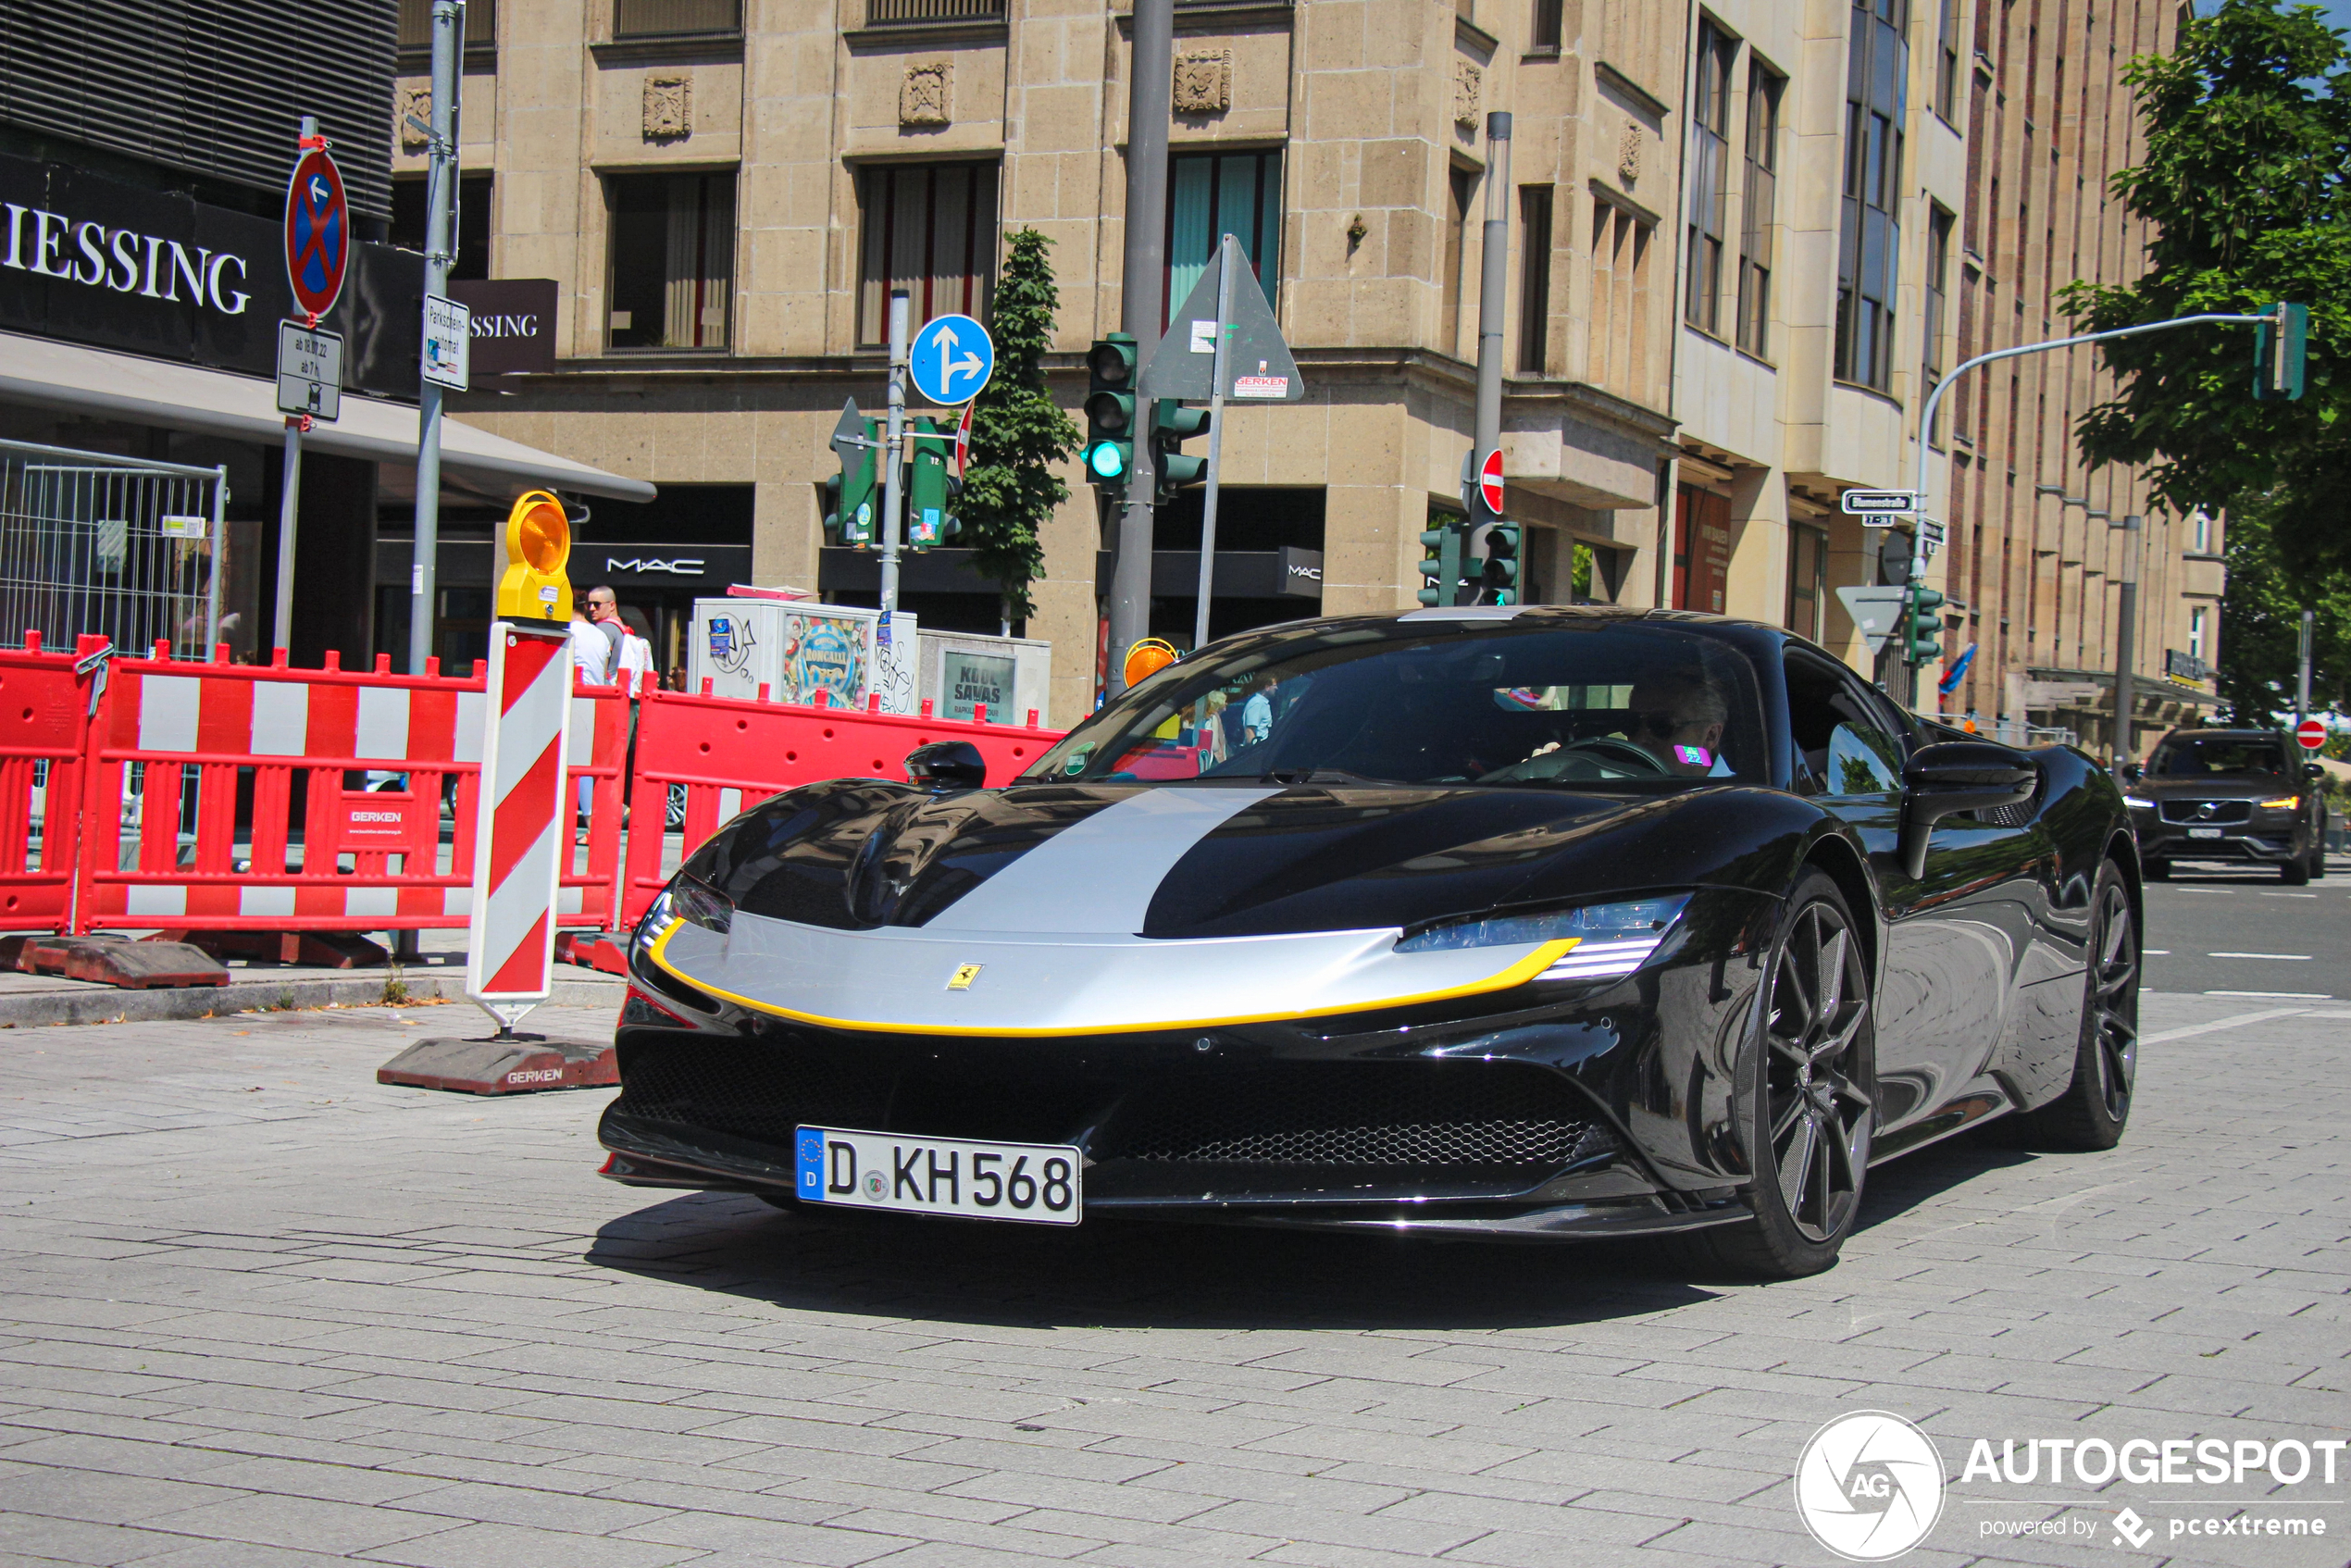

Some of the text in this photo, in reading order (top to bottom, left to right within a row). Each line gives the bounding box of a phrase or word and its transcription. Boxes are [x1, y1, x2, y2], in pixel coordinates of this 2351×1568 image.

[0, 202, 252, 315] IESSING
[470, 315, 538, 338] SSING
[295, 336, 304, 352] ab
[434, 334, 459, 355] automat
[301, 360, 309, 374] ab
[1236, 377, 1287, 386] GERKEN
[930, 456, 940, 466] 12
[1852, 496, 1907, 508] Blumenstraße
[1288, 565, 1322, 580] MAC
[960, 666, 999, 686] KOOL
[954, 683, 1001, 704] SAVAS
[954, 705, 976, 716] RAPKILL
[351, 811, 403, 822] GERKEN
[507, 1067, 563, 1084] GERKEN
[806, 1171, 817, 1187] D
